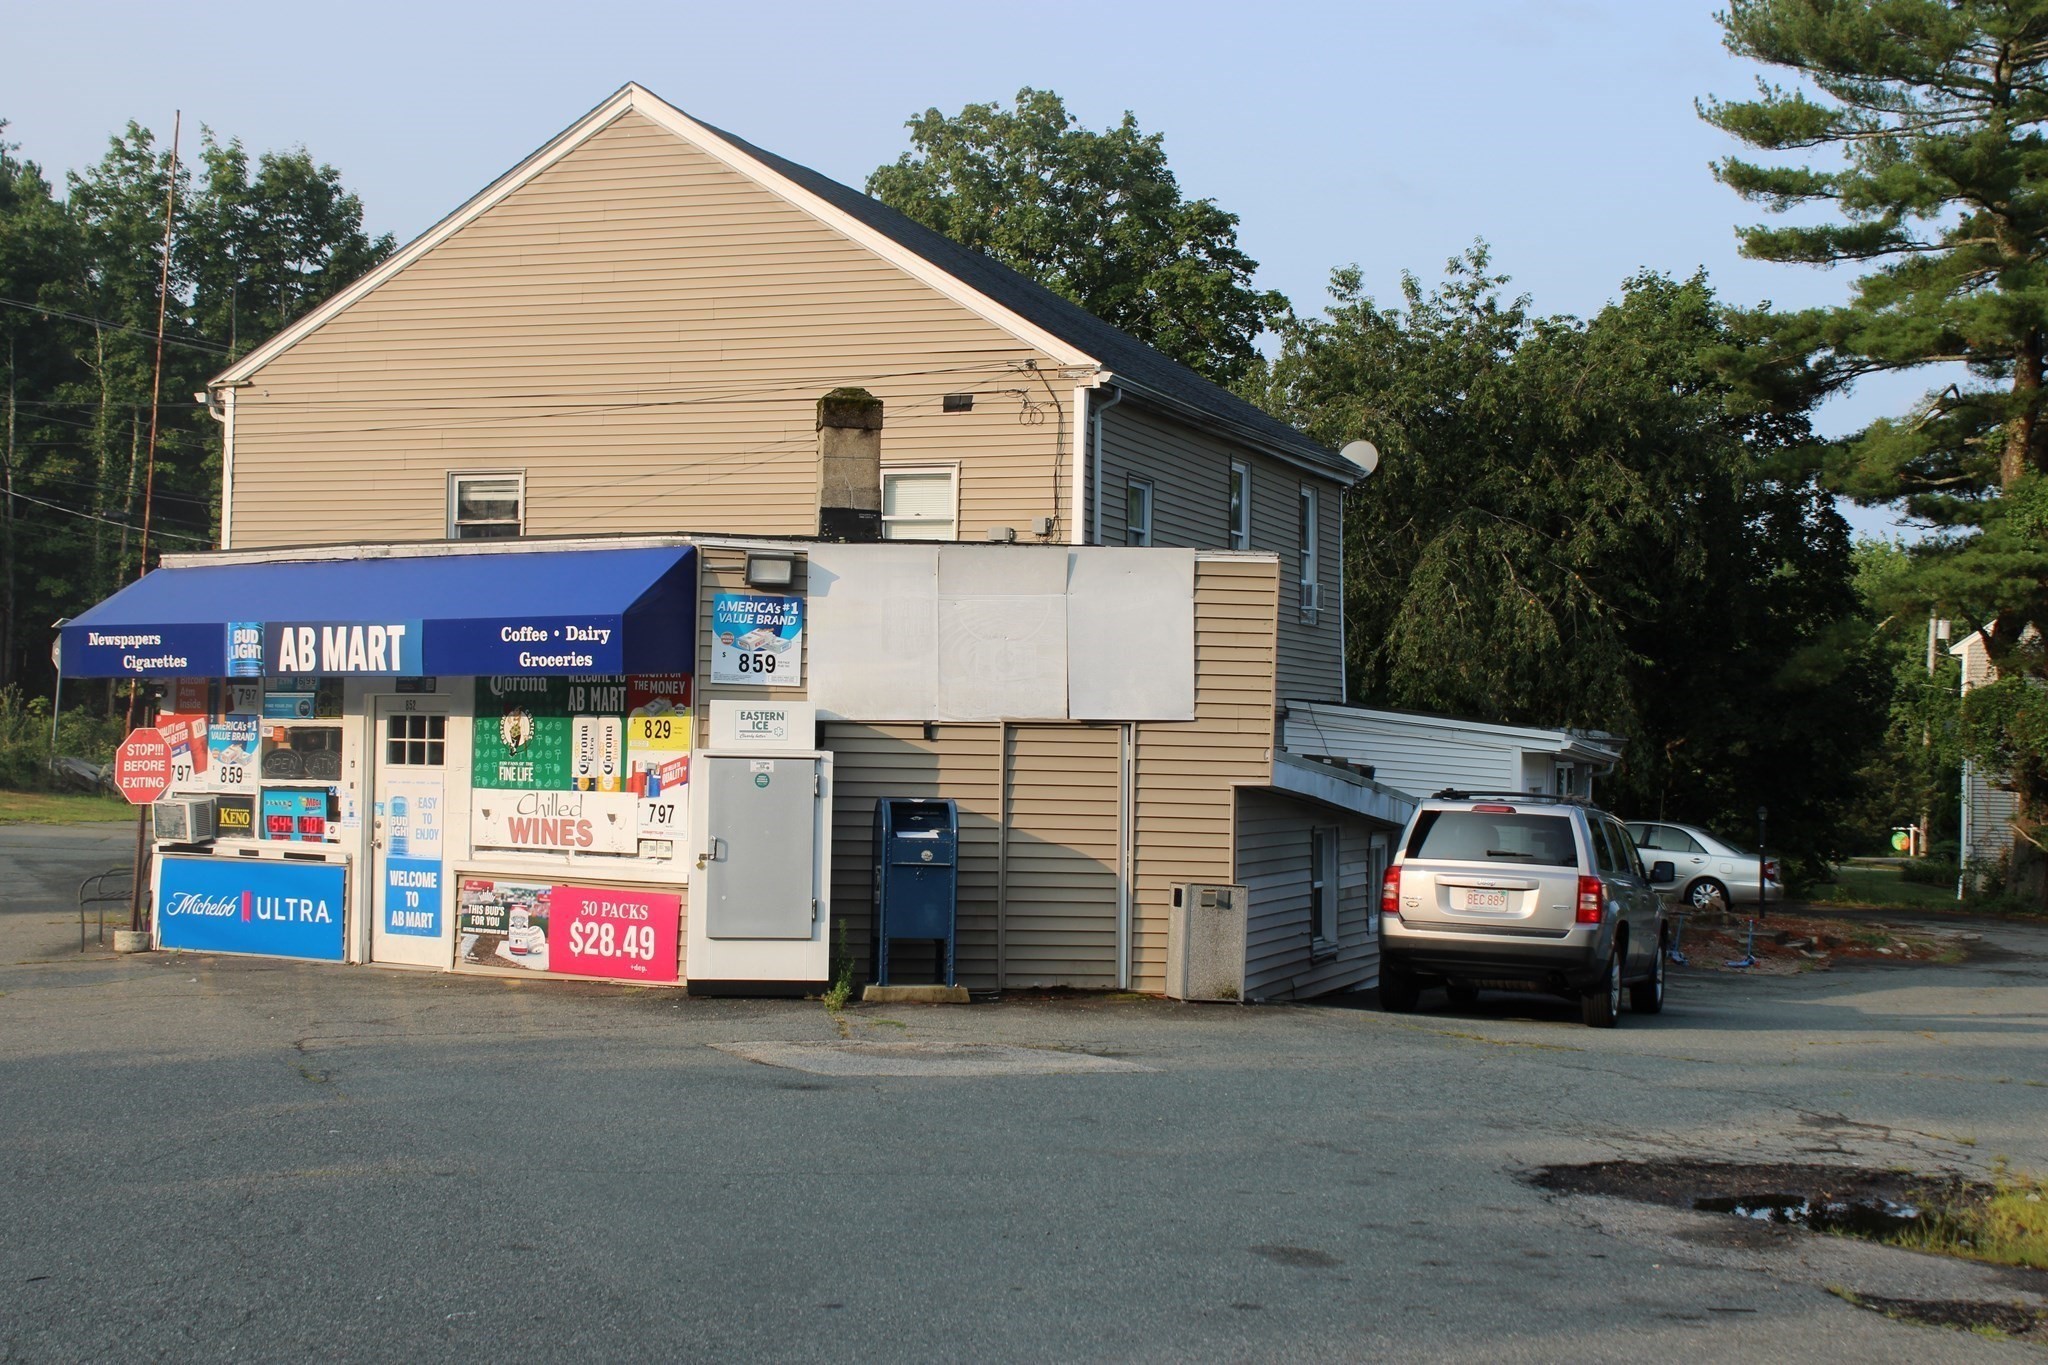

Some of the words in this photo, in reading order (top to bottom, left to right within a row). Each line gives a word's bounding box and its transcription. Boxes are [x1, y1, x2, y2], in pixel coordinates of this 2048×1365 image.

[717, 600, 781, 614] AMERICA's
[782, 601, 799, 615] #1
[719, 612, 755, 624] VALUE
[756, 614, 797, 626] BRAND
[88, 632, 161, 649] Newspapers
[233, 628, 259, 645] BUD
[500, 626, 548, 642] Coffee
[565, 625, 611, 645] Dairy
[230, 643, 262, 660] LIGHT
[278, 626, 317, 672] AB
[322, 624, 406, 672] MART
[123, 654, 188, 672] Cigarettes
[519, 651, 593, 667] Groceries
[738, 653, 776, 674] 859
[490, 675, 548, 698] Corona
[633, 680, 649, 691] THE
[649, 681, 686, 695] MONEY
[238, 688, 257, 706] 797
[567, 686, 585, 712] AB
[590, 686, 627, 712] MART
[740, 711, 785, 721] EASTERN
[644, 719, 671, 739] 829
[751, 721, 769, 730] ICE
[211, 731, 231, 741] VALUE
[231, 731, 256, 741] BRAND
[126, 743, 164, 757] STOP!!!
[579, 725, 590, 775] Corona
[603, 725, 614, 775] Corona
[123, 760, 166, 772] BEFORE
[266, 758, 297, 770] OPEN
[313, 758, 335, 770] ATM
[220, 766, 243, 784] 859
[499, 766, 517, 782] FINE
[517, 766, 534, 782] LIFE
[122, 777, 165, 789] EXITING
[418, 796, 437, 809] EASY
[516, 792, 583, 818] Chilled
[220, 807, 250, 825] KENO
[391, 816, 408, 826] BUD
[422, 812, 433, 825] TO
[648, 803, 675, 824] 797
[415, 828, 440, 841] ENJOY
[507, 816, 594, 847] WINES
[389, 870, 438, 889] WELCOME
[166, 891, 239, 917] Michelob
[256, 896, 331, 924] ULTRA
[405, 890, 420, 908] TO
[1487, 894, 1505, 906] 889
[468, 904, 484, 915] THIS
[485, 905, 505, 917] BUD'S
[580, 900, 598, 917] 30
[600, 901, 649, 921] PACKS
[391, 910, 405, 927] AB
[405, 911, 434, 929] MART
[471, 915, 485, 926] FOR
[486, 916, 500, 927] YOU
[568, 917, 655, 961] $28.49
